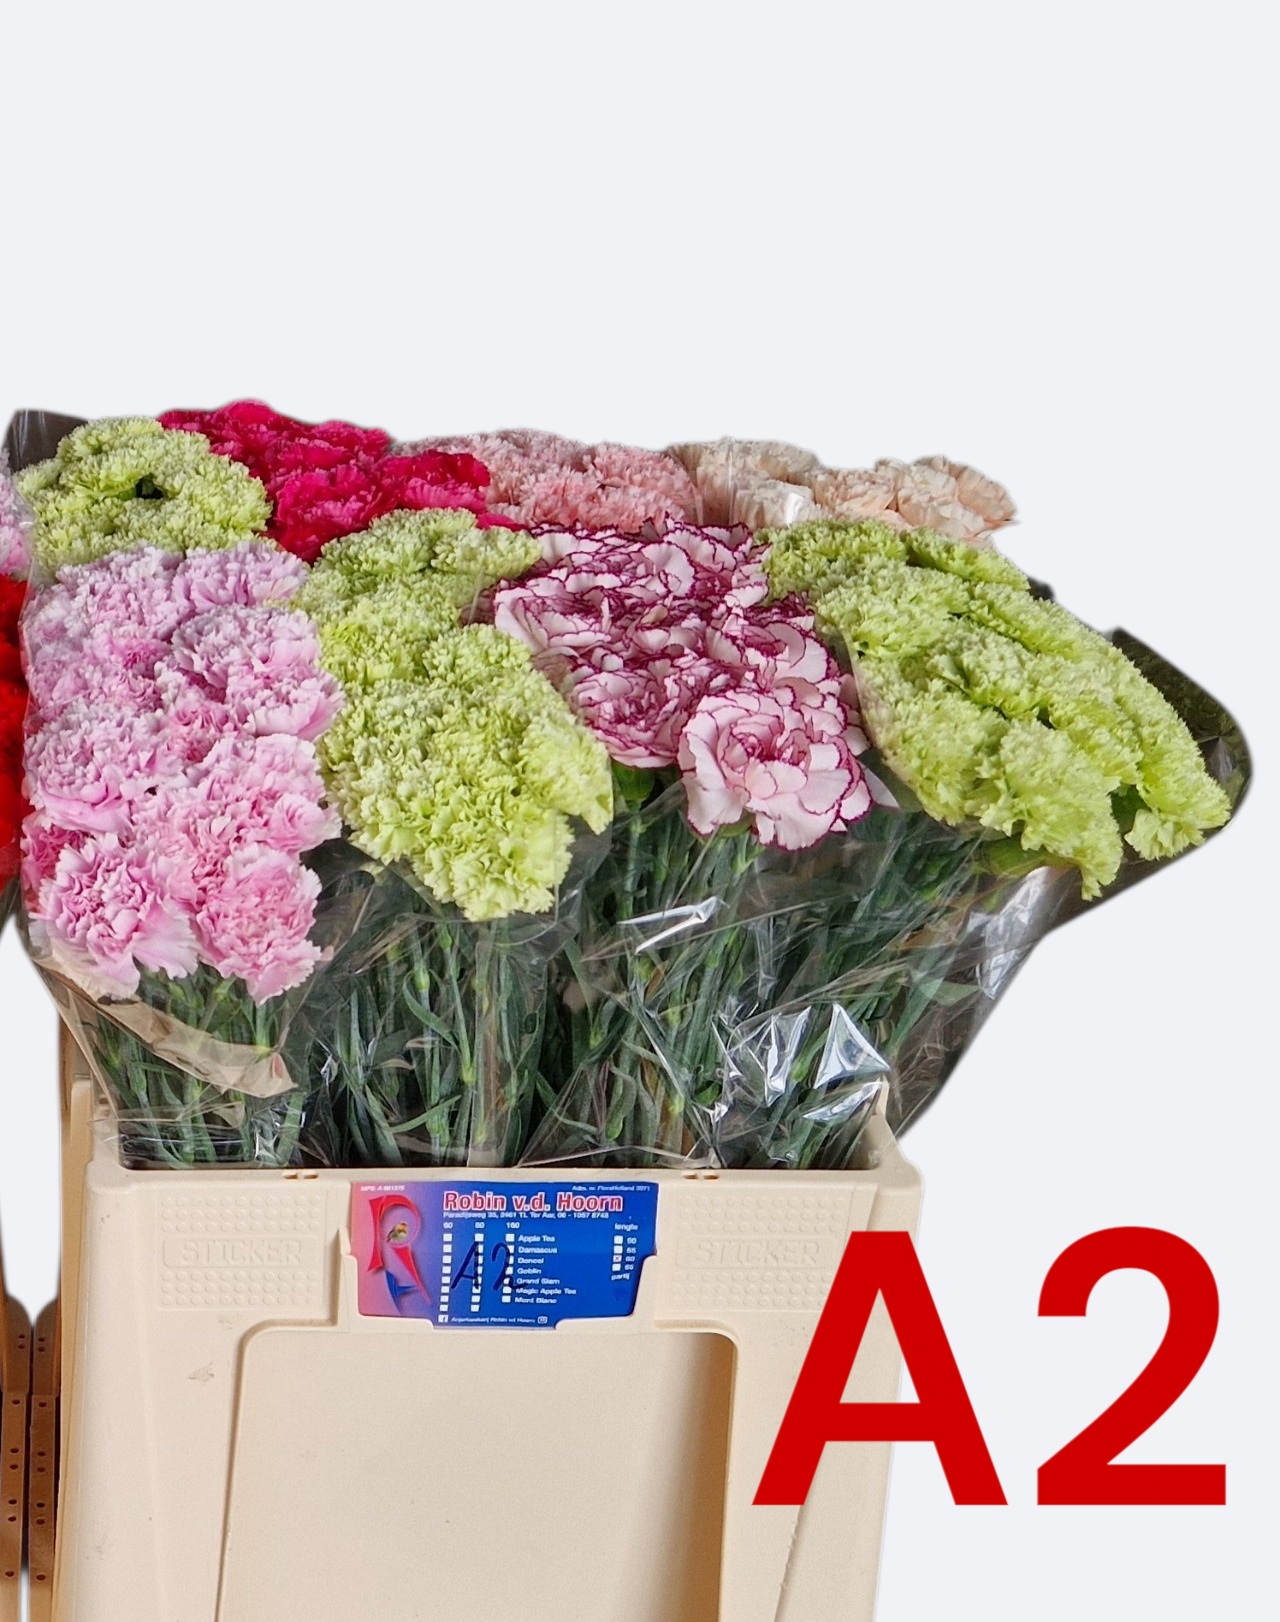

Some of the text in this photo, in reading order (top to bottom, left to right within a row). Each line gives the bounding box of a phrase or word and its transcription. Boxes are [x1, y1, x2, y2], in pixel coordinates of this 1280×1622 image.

[443, 1191, 623, 1211] Robin v.d. Hoorn
[518, 1235, 541, 1243] Apple
[182, 1239, 302, 1266] STICKER
[518, 1246, 558, 1254] Damascus
